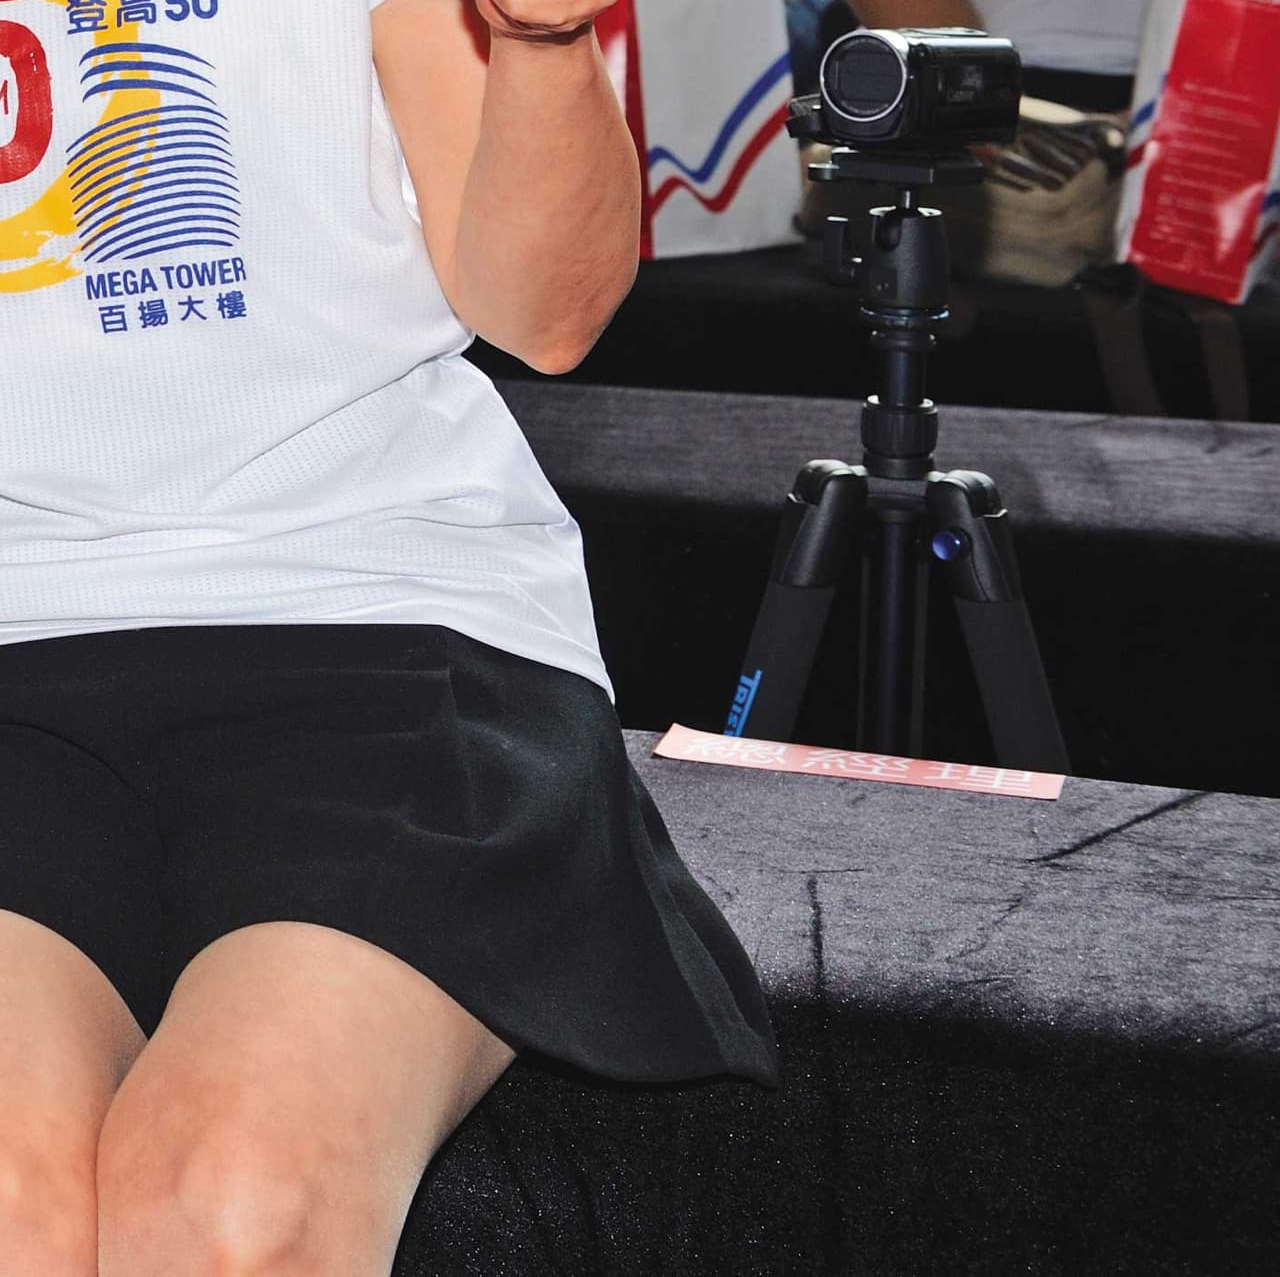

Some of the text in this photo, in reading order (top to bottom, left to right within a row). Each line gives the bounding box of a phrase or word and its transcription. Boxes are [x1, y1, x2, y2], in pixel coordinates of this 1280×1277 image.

[85, 257, 247, 301] MEGA TOWER
[98, 290, 247, 334] 百揚大樓
